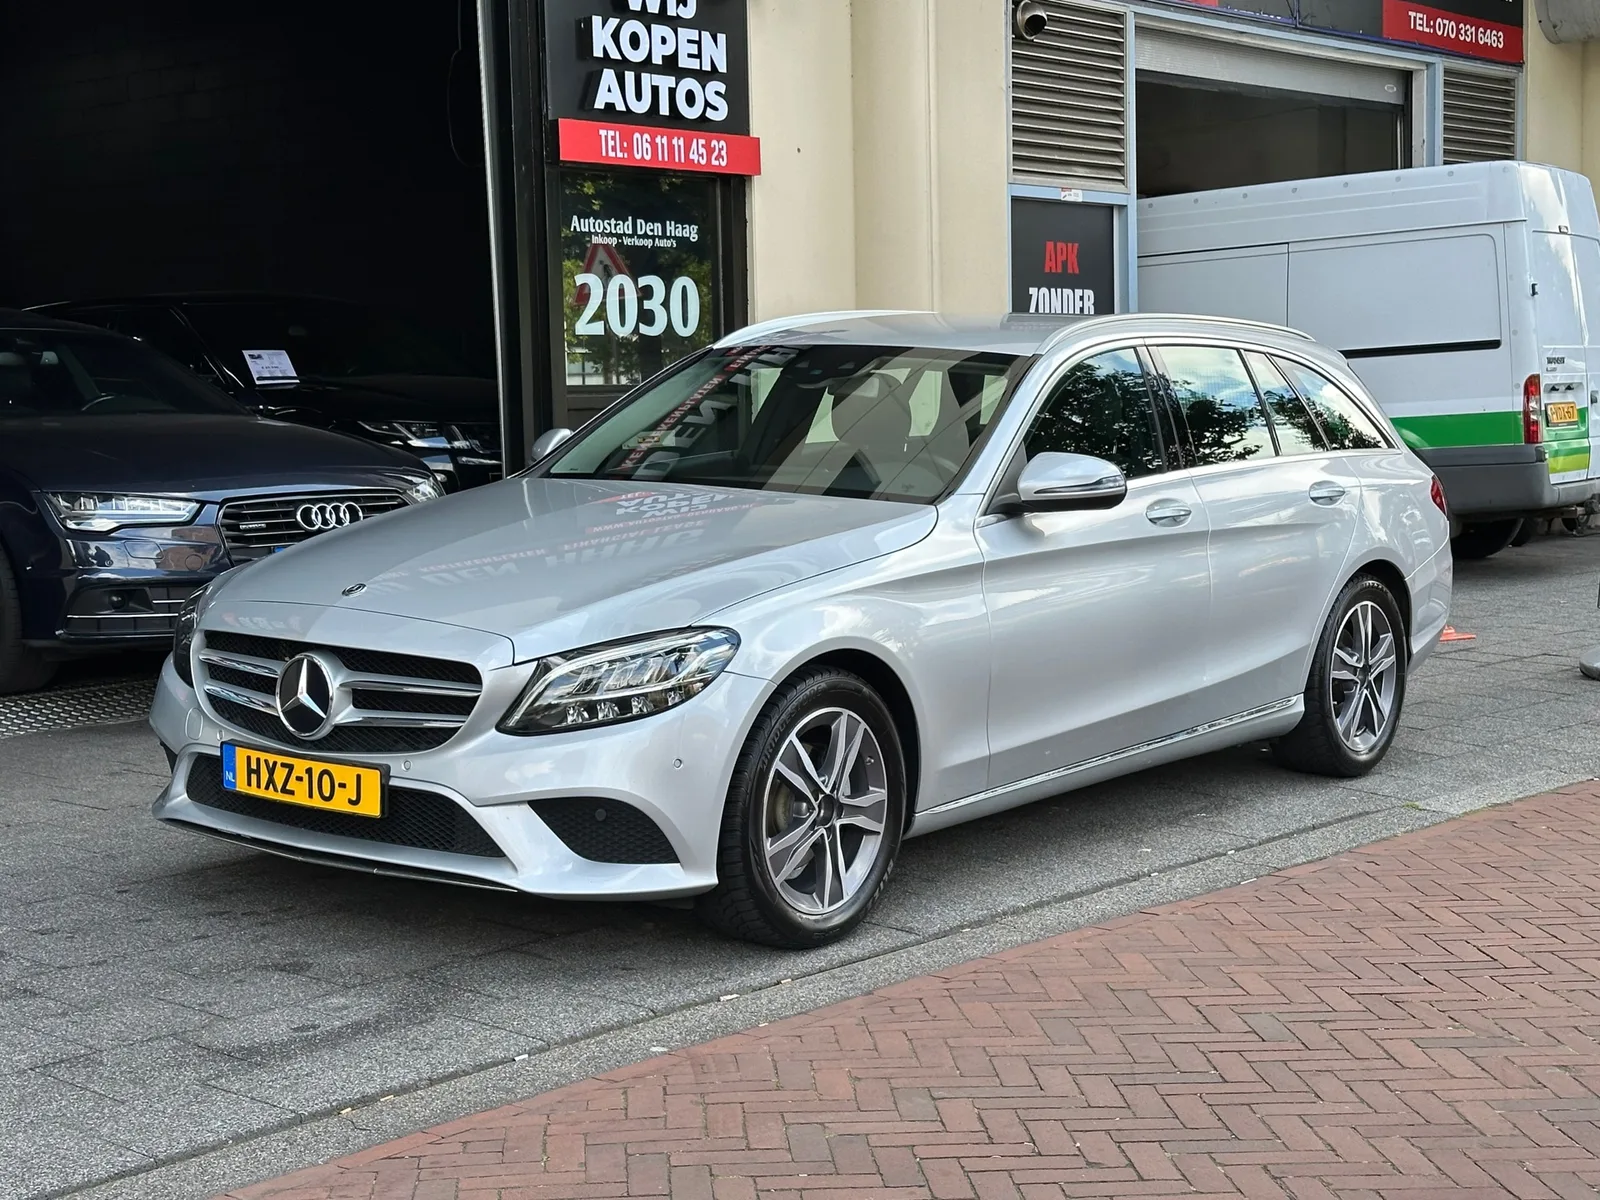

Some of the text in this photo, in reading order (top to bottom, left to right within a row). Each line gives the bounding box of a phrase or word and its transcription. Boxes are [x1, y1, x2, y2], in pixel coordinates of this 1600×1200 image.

[591, 15, 728, 74] KOPEN
[1408, 11, 1504, 49] TEL: 070 331 6463
[593, 68, 729, 122] AUTOS
[599, 129, 728, 167] TEL: 06 11 11 45 23
[570, 215, 699, 242] Autostad Den Haag
[591, 234, 618, 247] Inkoop
[622, 236, 653, 249] Verkoop
[654, 237, 677, 248] Auto's
[1044, 240, 1080, 275] APK
[573, 273, 700, 338] 2030
[1028, 287, 1095, 315] ZONDER
[225, 770, 236, 783] NL
[246, 755, 363, 807] HXZ-10-J
